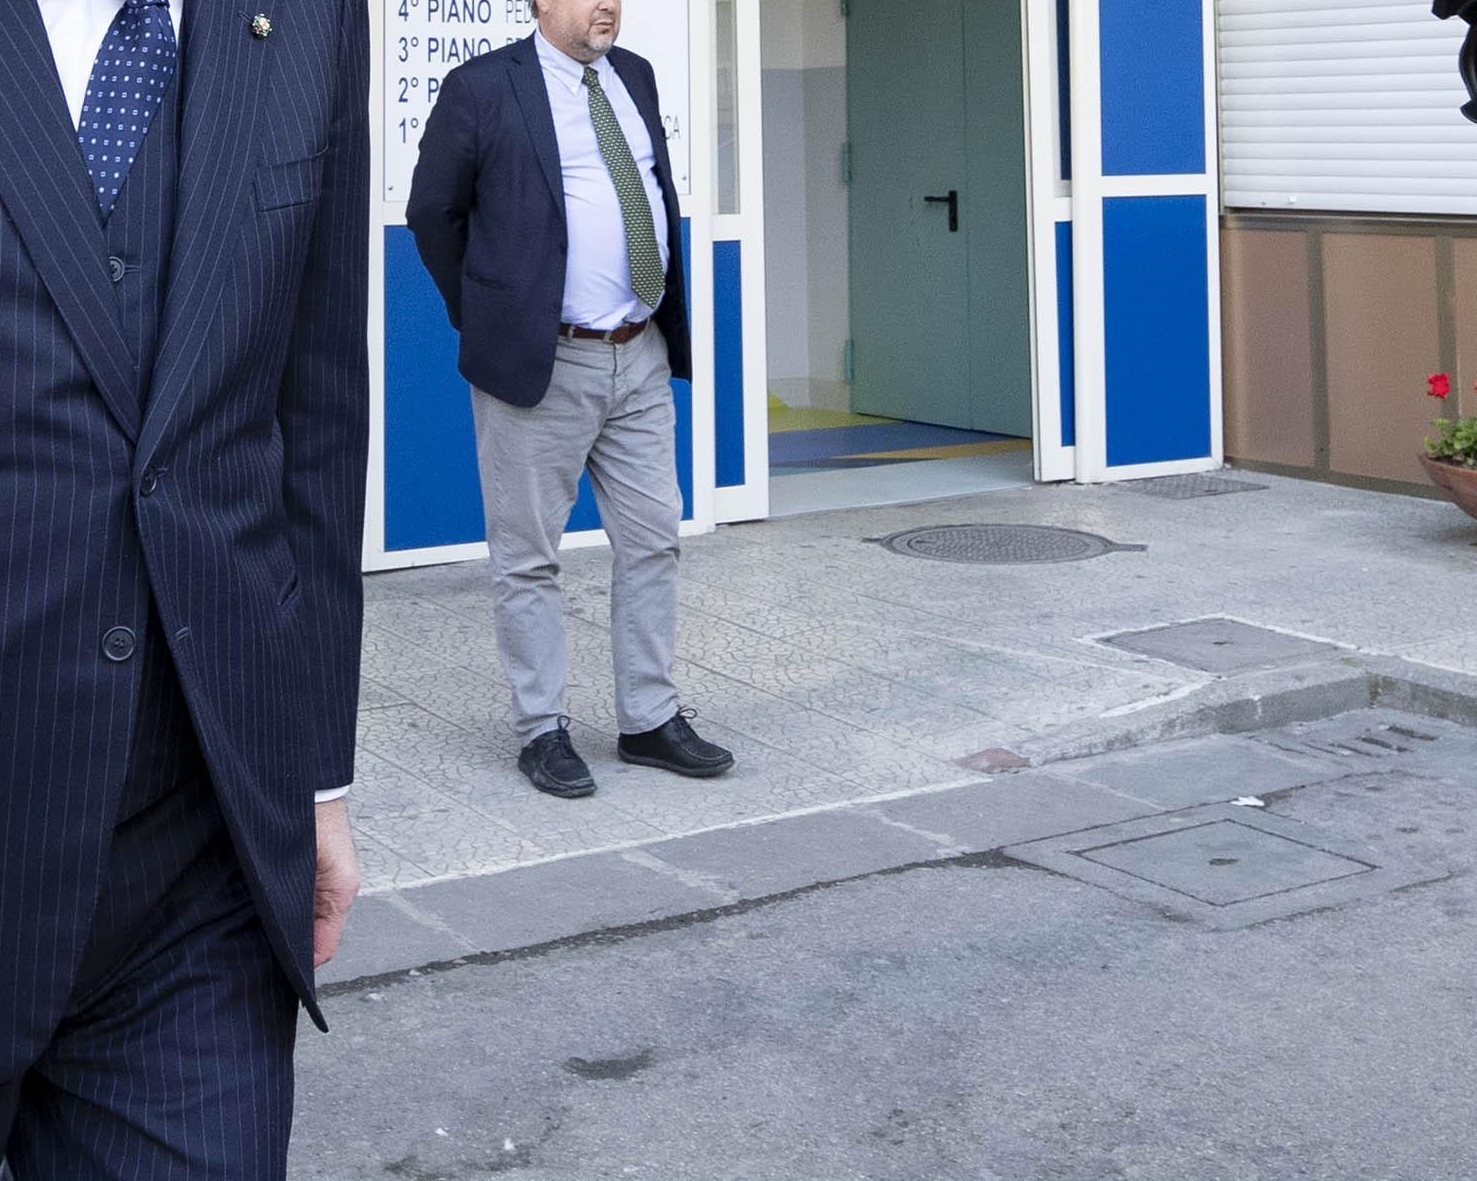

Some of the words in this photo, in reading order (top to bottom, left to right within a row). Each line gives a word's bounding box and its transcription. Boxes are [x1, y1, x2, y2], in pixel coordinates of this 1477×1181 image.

[398, 36, 419, 62] 3°
[427, 37, 491, 63] PIANO
[398, 76, 419, 103] 2°
[398, 117, 419, 144] 1°
